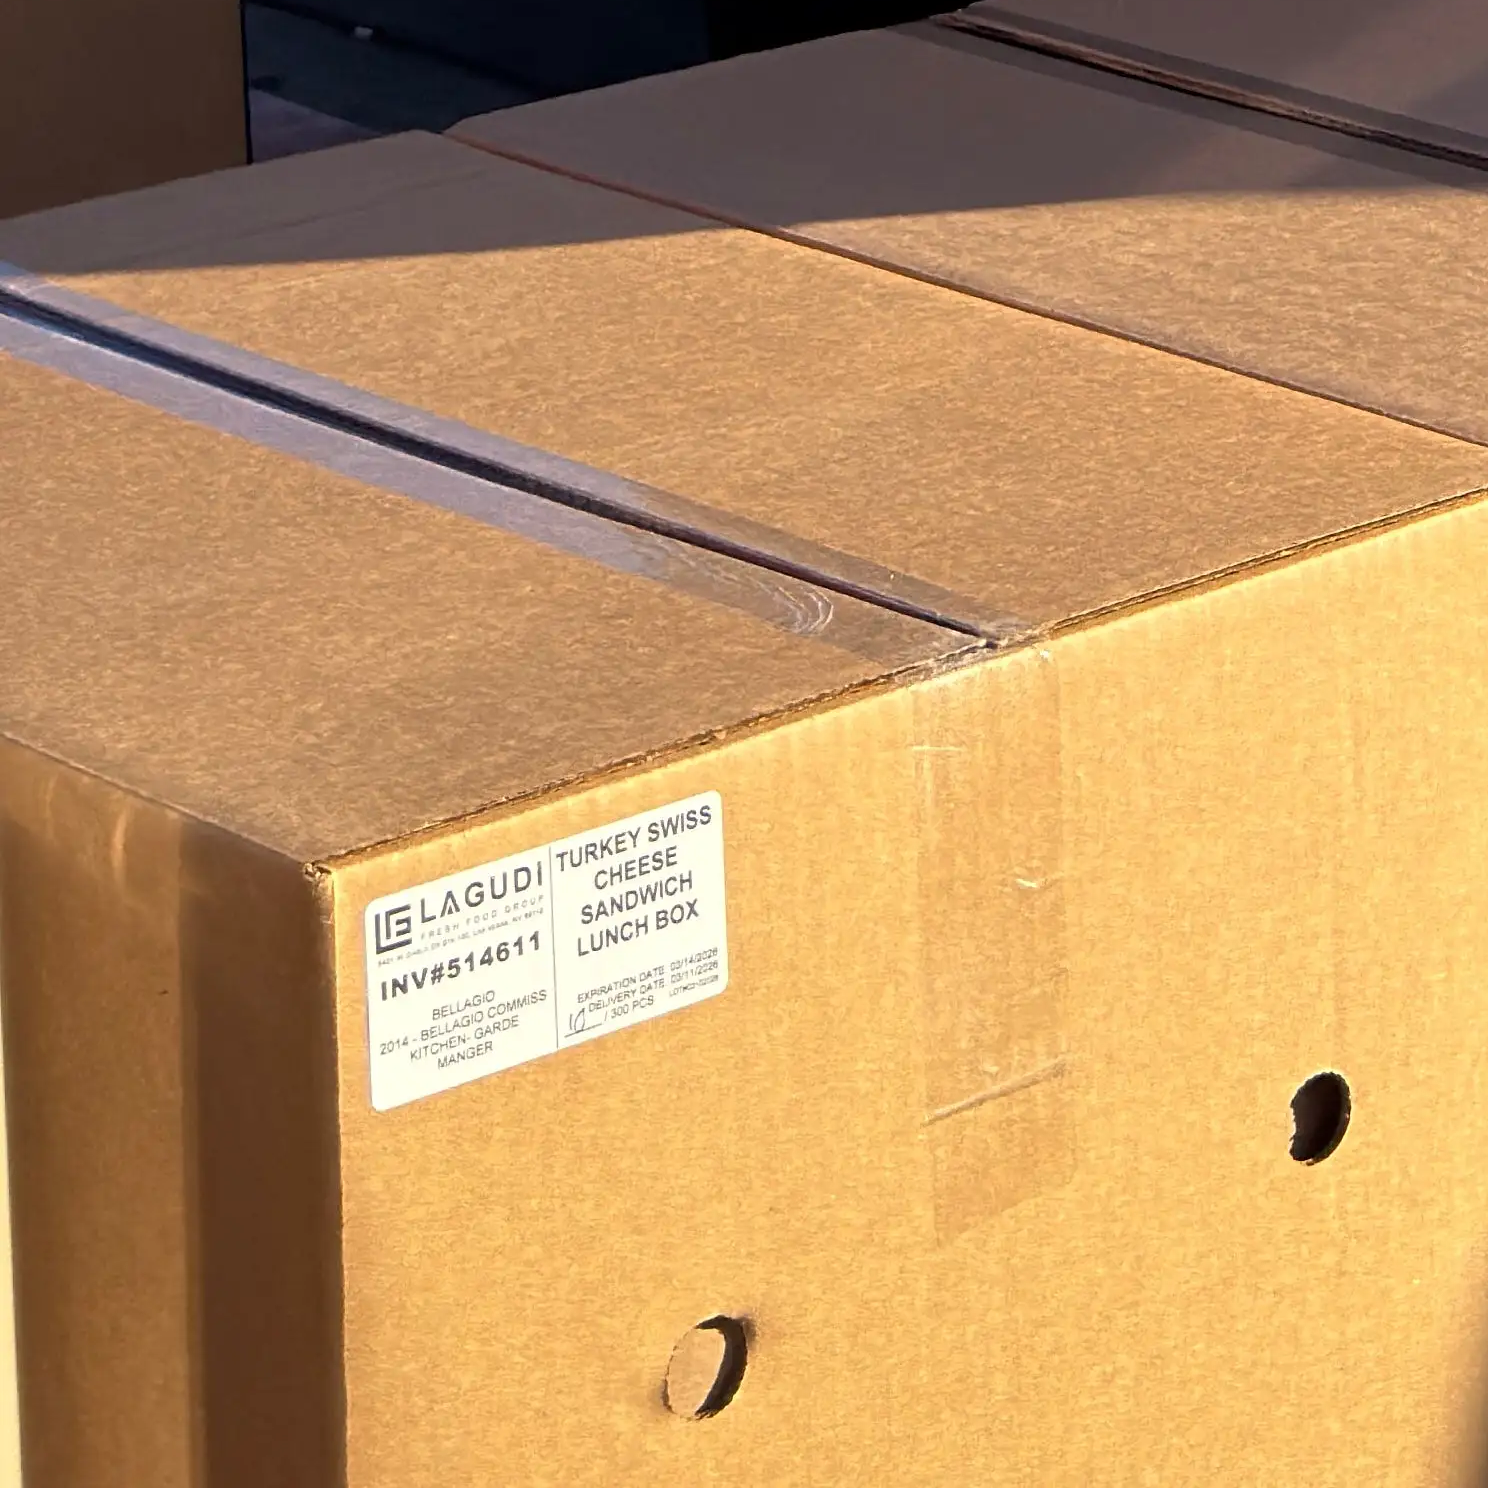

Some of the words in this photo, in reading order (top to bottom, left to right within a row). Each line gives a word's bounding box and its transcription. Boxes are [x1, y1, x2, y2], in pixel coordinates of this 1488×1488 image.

[557, 827, 640, 872] TURKEY
[648, 805, 711, 843] SWISS
[594, 846, 677, 889] CHEESE
[421, 861, 543, 923] LAGUDI
[581, 870, 693, 925] SANDWICH
[577, 913, 648, 956] LUNCH
[656, 899, 698, 930] BOX
[381, 931, 540, 1001] INV#514611
[433, 990, 495, 1021] BELLAGIO
[578, 976, 636, 1004] EXPIRATION
[589, 989, 636, 1013] DELIVERY
[611, 1004, 629, 1019] 300
[632, 996, 654, 1010] PCS
[380, 1037, 408, 1055] 2014
[421, 1011, 484, 1041] BELLAGIO
[487, 990, 547, 1020] COMMISS
[475, 1015, 519, 1042] GARDE
[438, 1041, 493, 1068] MANGER
